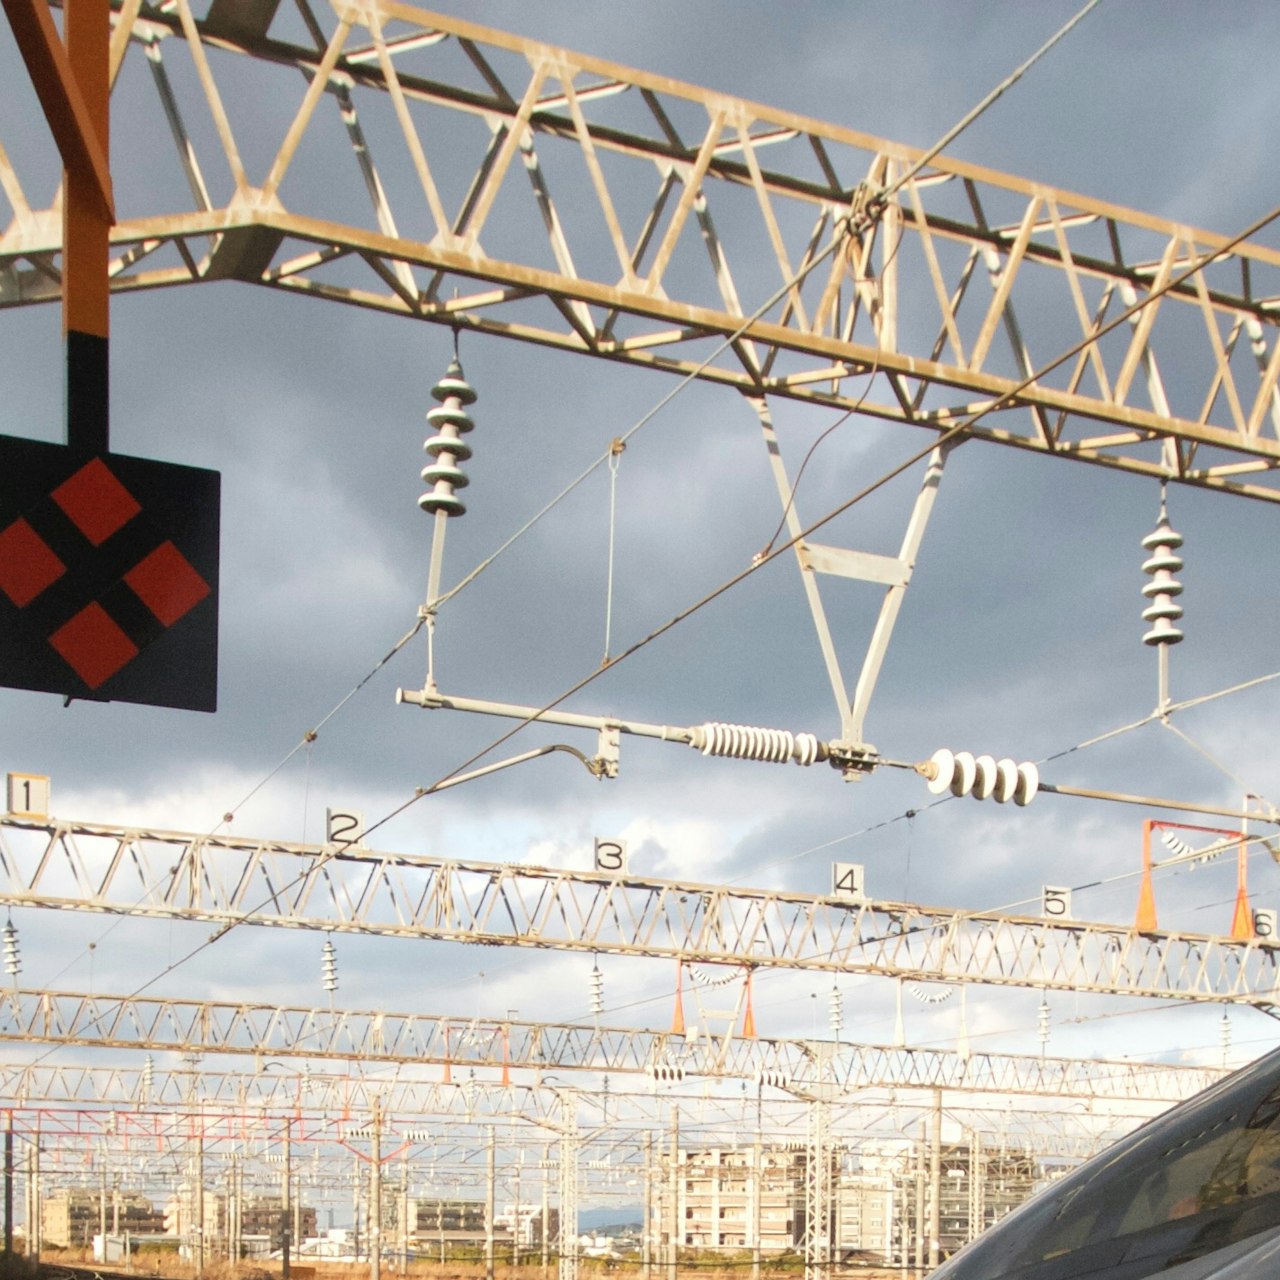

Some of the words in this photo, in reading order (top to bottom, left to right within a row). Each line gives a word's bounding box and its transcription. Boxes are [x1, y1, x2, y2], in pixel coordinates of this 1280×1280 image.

[23, 779, 31, 811] 1
[330, 813, 359, 844] 2
[597, 842, 623, 870] 3
[836, 869, 858, 894] 4
[1045, 890, 1066, 915] 5
[1255, 913, 1272, 937] 6
